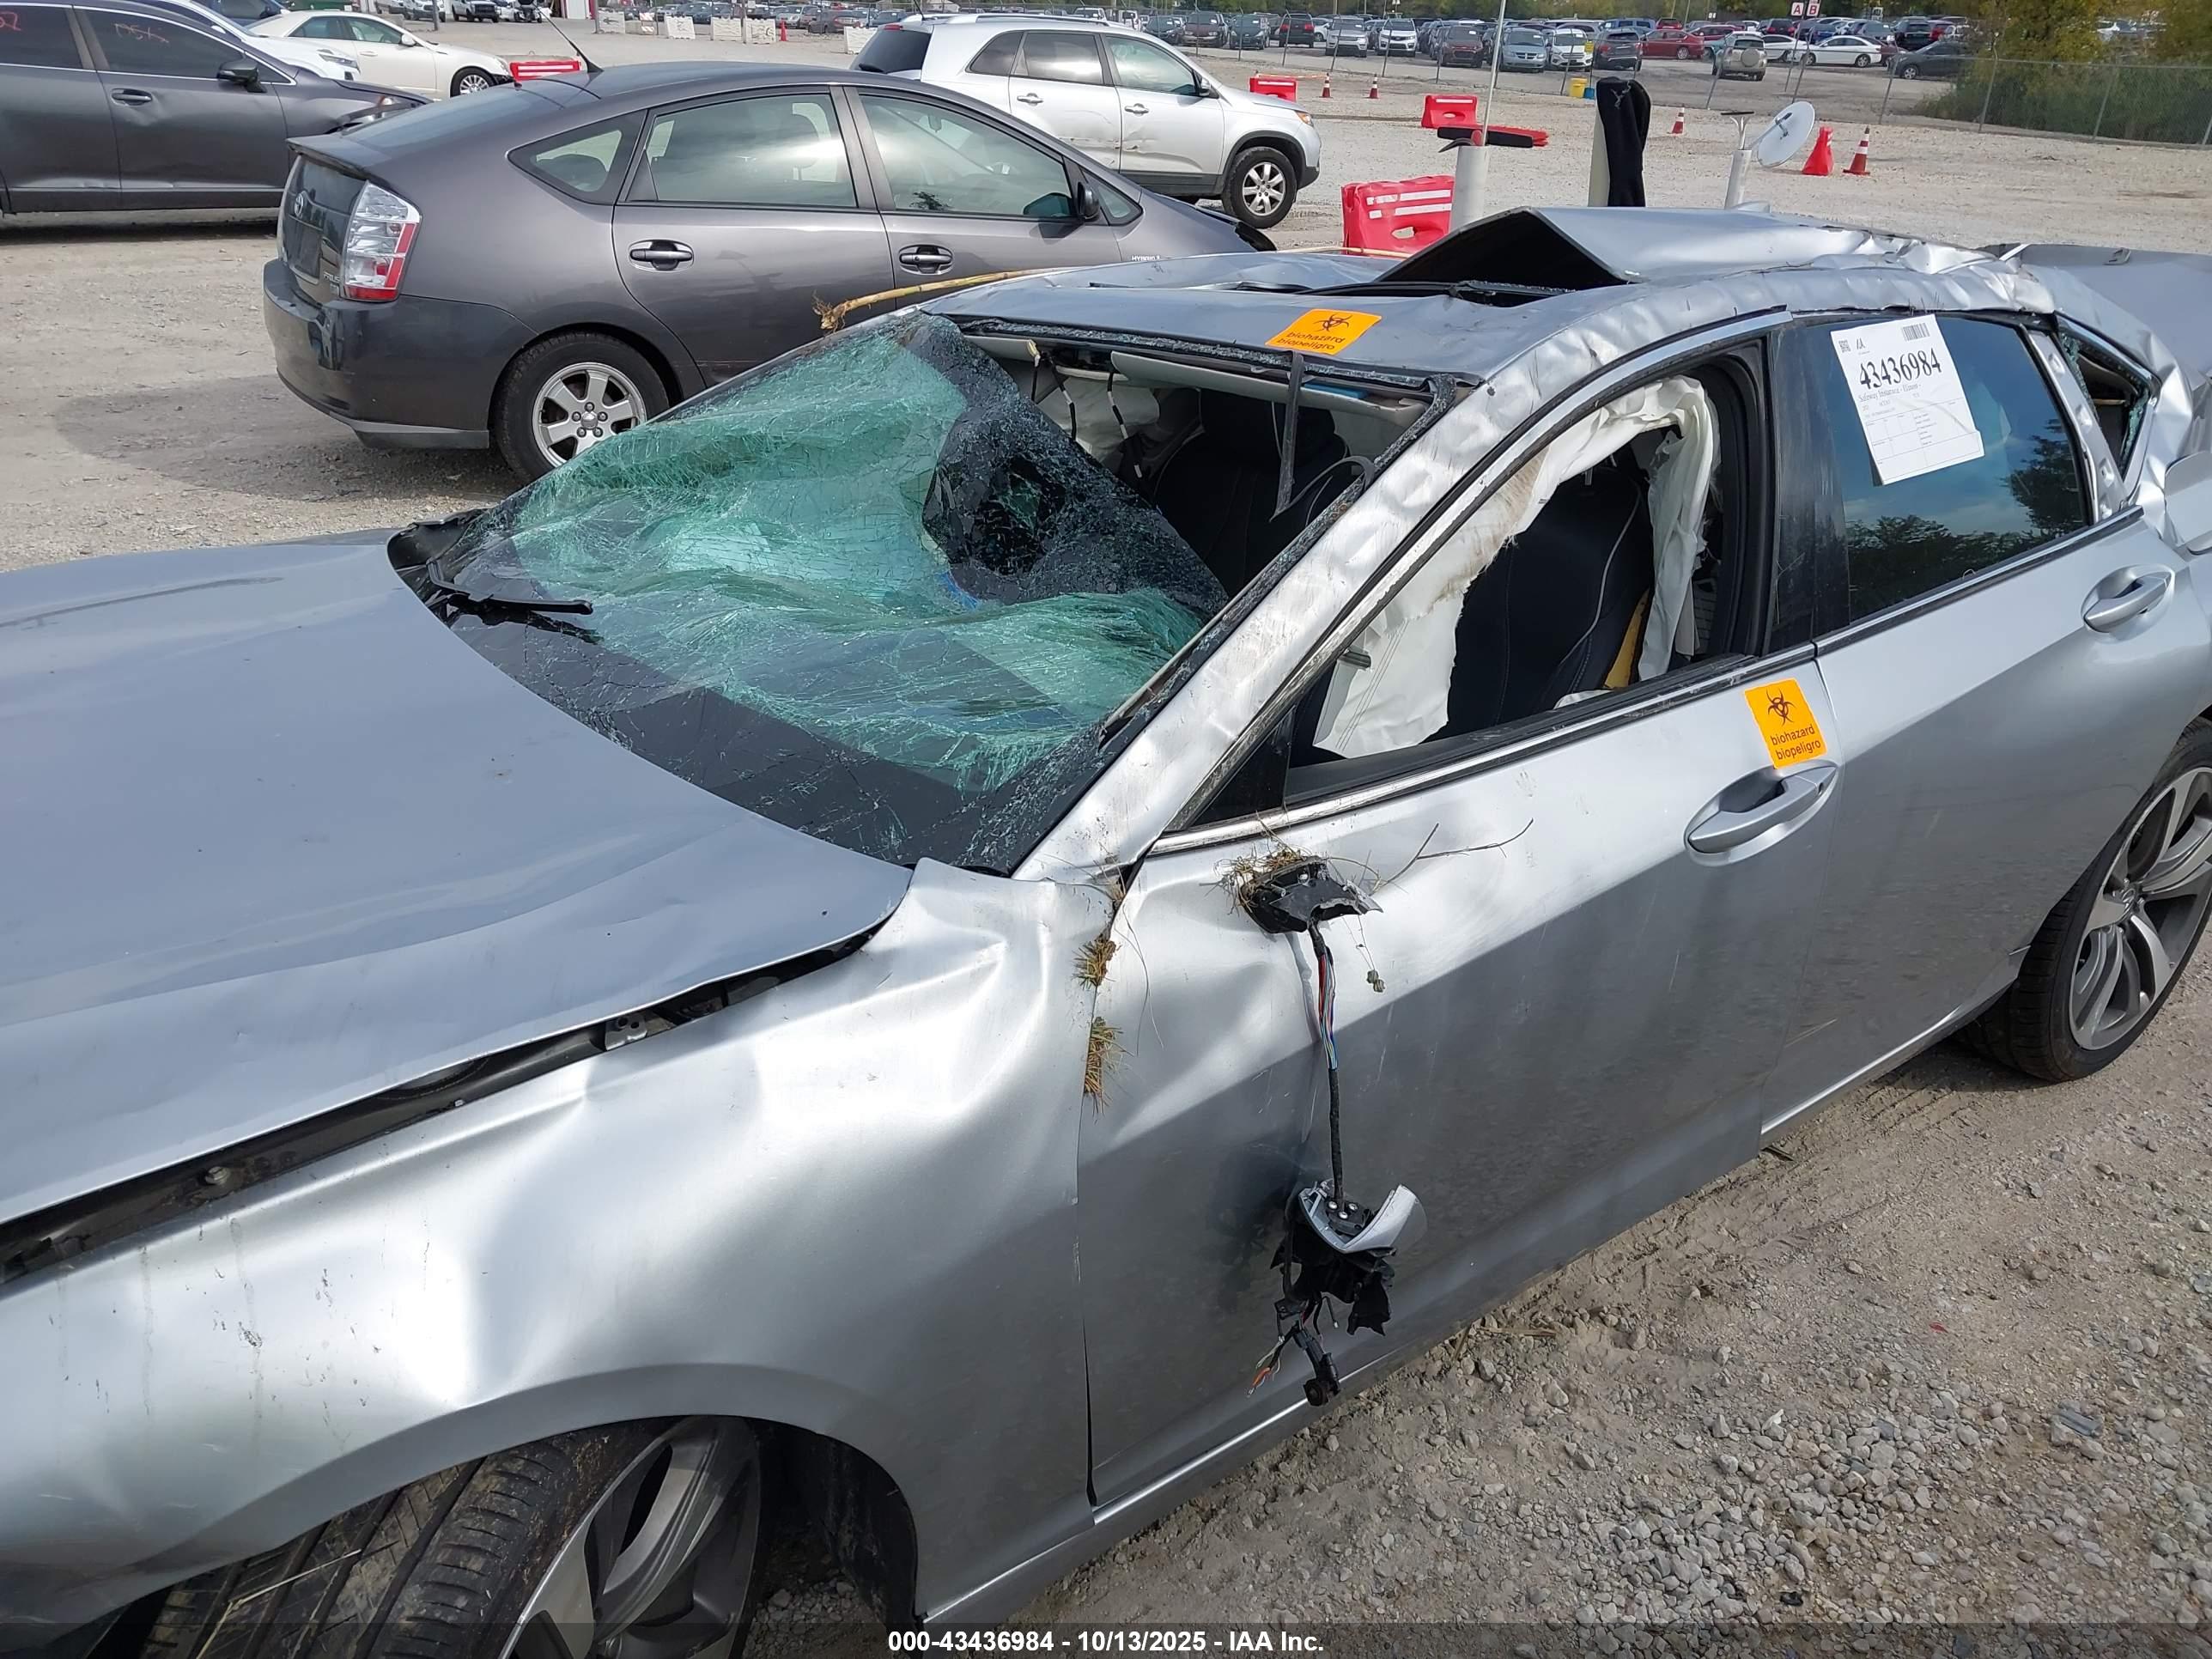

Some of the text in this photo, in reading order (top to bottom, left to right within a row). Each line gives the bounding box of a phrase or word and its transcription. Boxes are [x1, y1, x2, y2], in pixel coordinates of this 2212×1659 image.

[1793, 4, 1801, 14] A
[1809, 5, 1817, 15] B
[1286, 331, 1346, 343] biohazard
[1276, 338, 1334, 350] biopeligro
[1859, 348, 1942, 390] 43436984
[1771, 723, 1815, 745] biohazard
[1776, 739, 1821, 760] biopeligro
